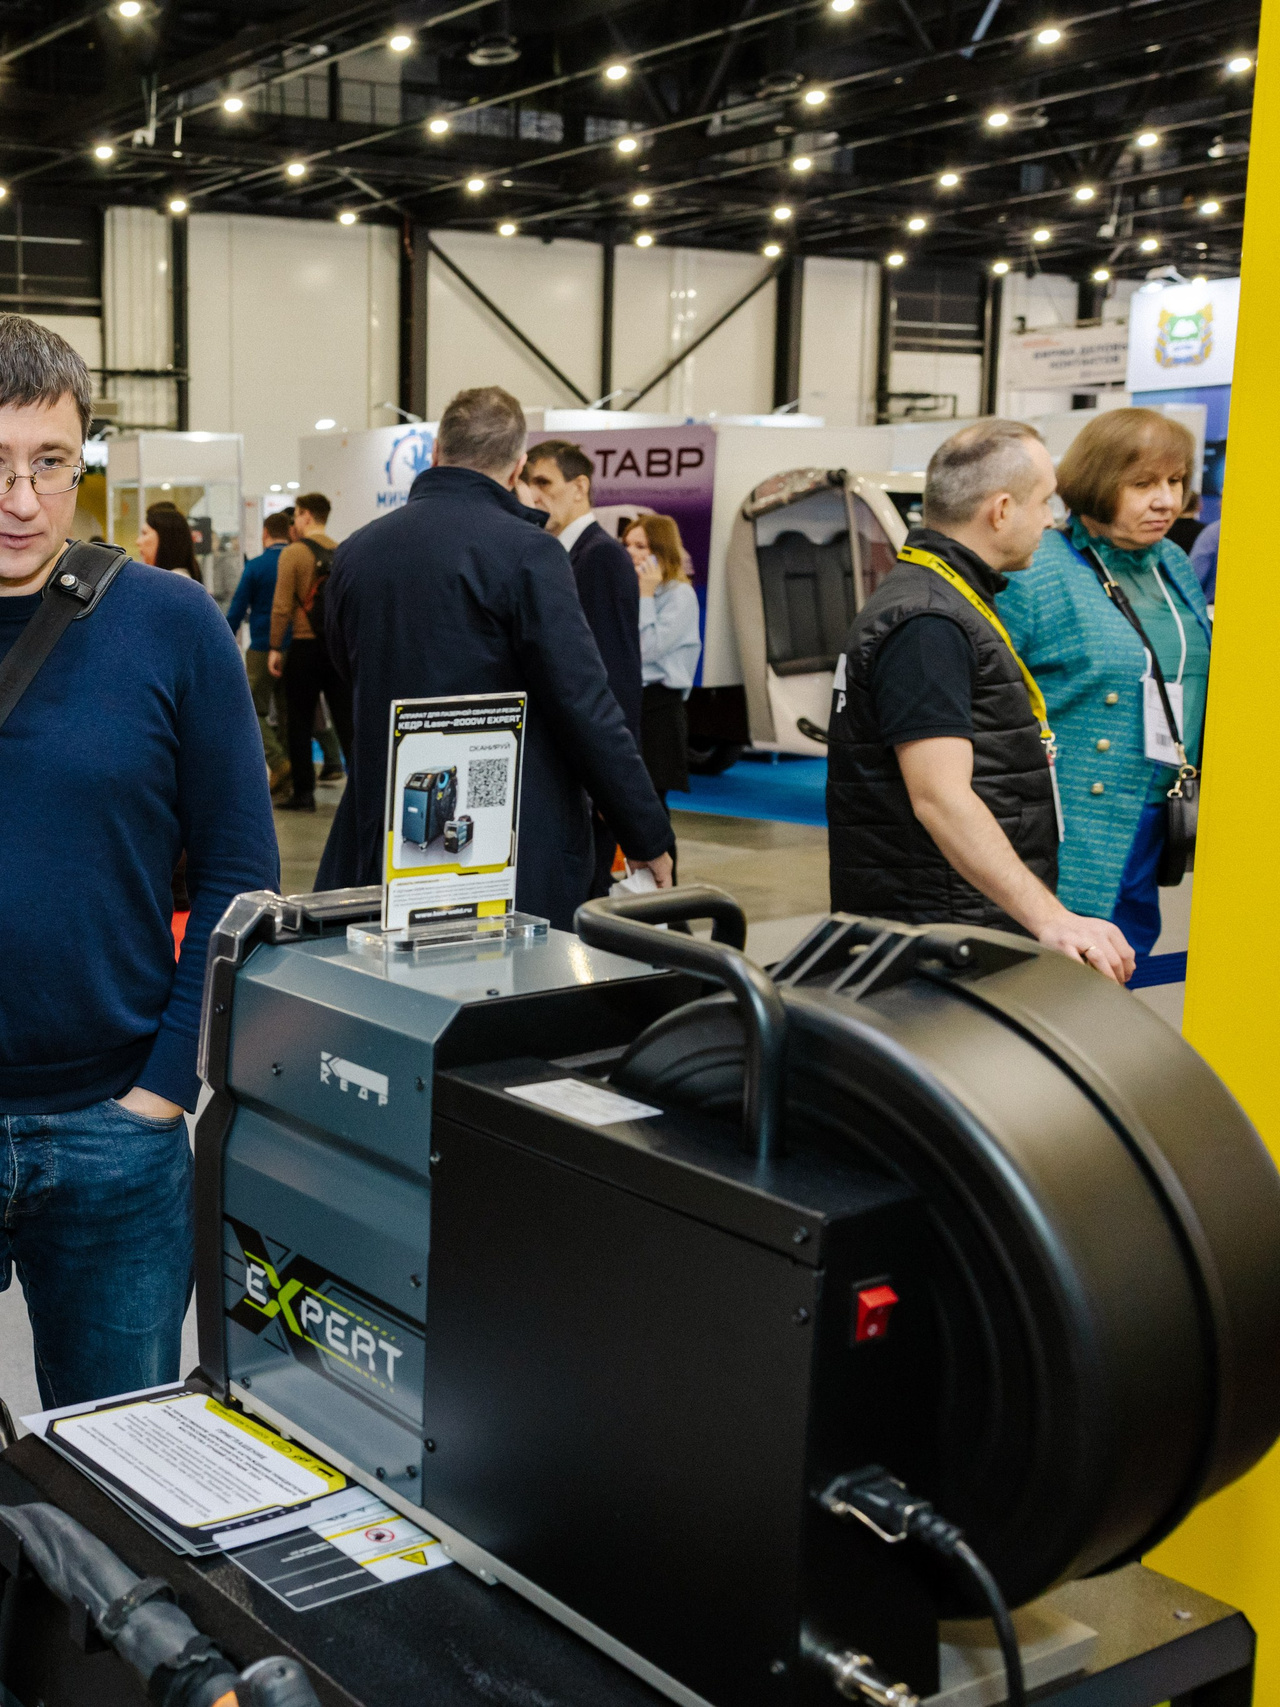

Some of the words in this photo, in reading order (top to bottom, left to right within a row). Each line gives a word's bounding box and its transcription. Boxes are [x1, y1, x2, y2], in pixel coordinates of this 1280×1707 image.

[487, 714, 522, 725] EXPERT
[320, 1069, 389, 1107] КЕДР
[245, 1252, 404, 1384] EXPERT
